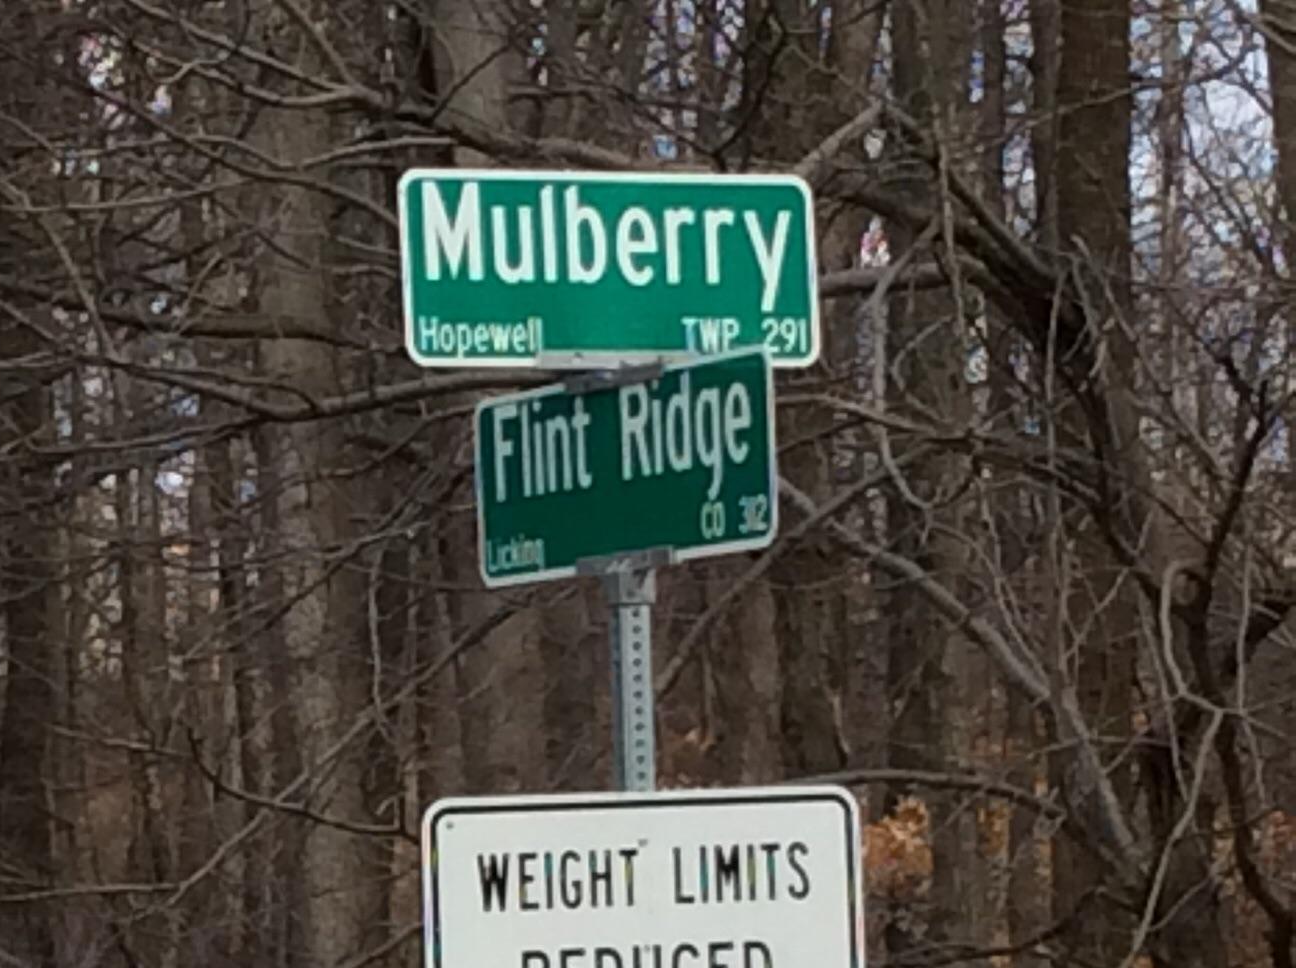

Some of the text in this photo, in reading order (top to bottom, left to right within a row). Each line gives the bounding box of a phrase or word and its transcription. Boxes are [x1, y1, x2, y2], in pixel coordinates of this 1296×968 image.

[420, 181, 791, 313] Mulberry
[418, 317, 543, 357] Hopewell
[683, 317, 807, 353] TWP 291
[492, 371, 751, 501] Flint Ridge
[477, 841, 812, 912] WEIGHT LIMITS
